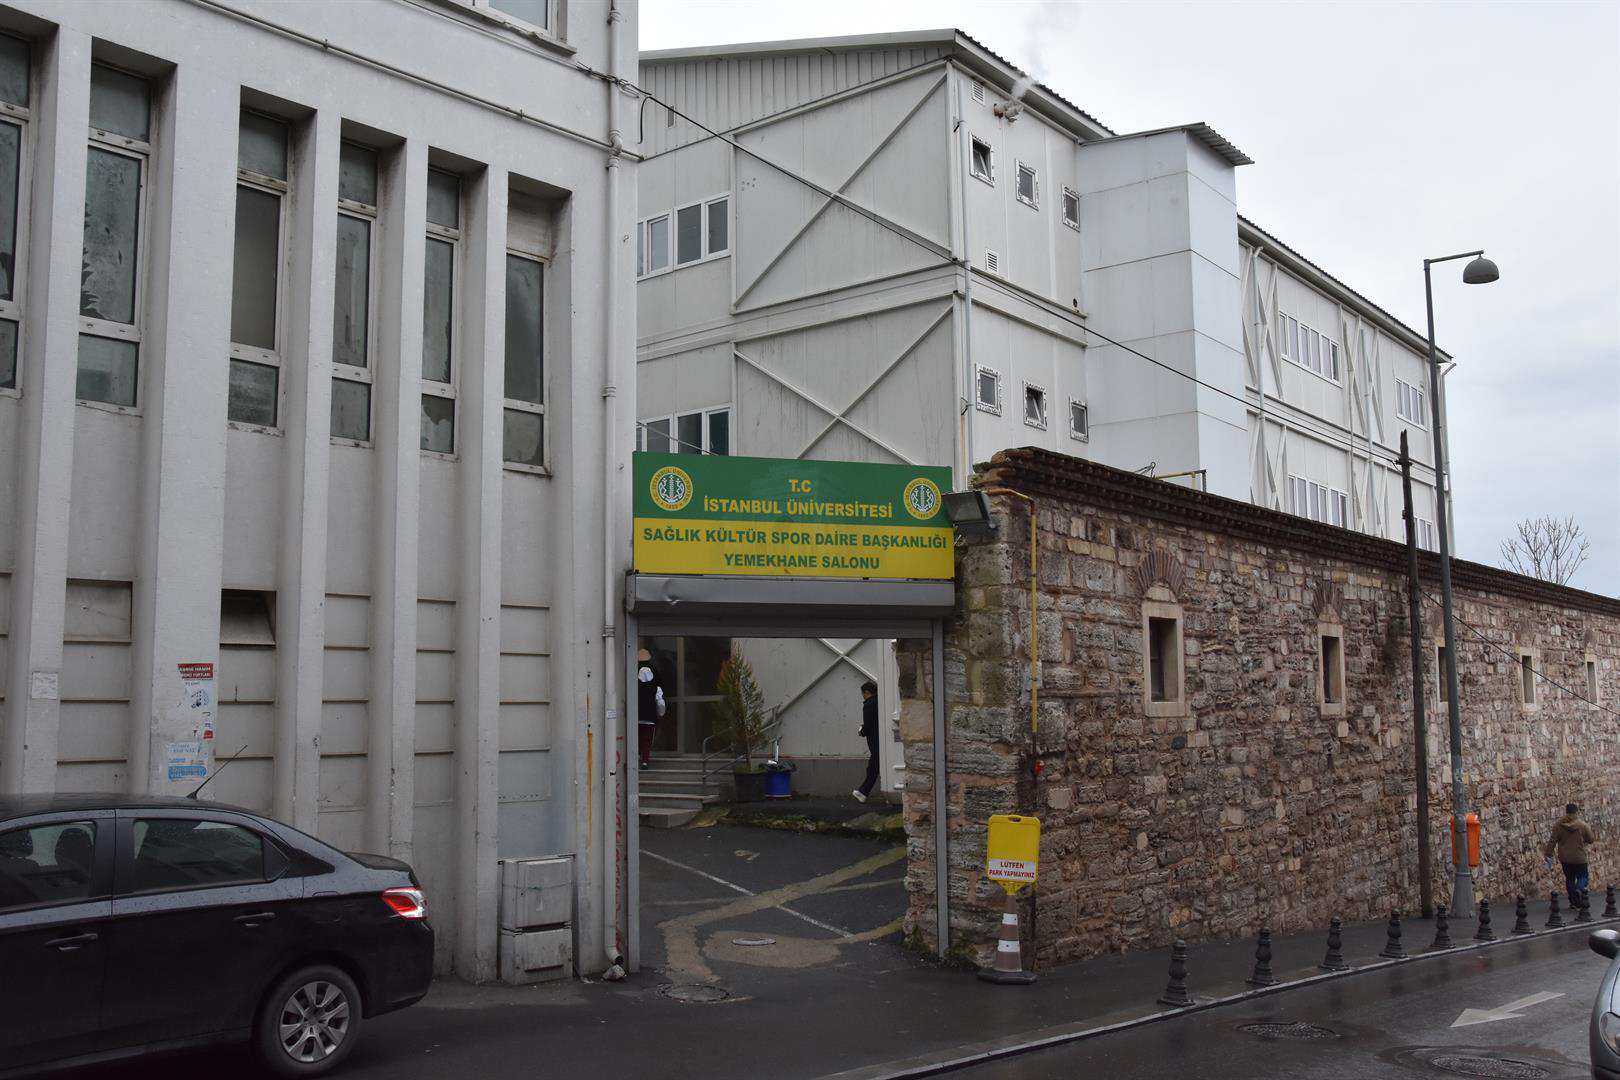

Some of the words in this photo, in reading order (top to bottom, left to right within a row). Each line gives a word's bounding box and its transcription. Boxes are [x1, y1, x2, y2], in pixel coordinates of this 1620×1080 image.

[789, 479, 812, 493] T.C
[703, 495, 782, 514] İSTANBUL
[787, 498, 893, 518] ÜNİVERSİTESİ
[643, 526, 701, 542] SAĞLIK
[705, 527, 767, 544] KÜLTÜR
[771, 531, 810, 545] SPOR
[815, 531, 857, 547] DAİRE
[862, 533, 947, 551] BAŞKANLIĞI
[724, 553, 817, 568] YEMEKHANE
[822, 555, 880, 569] SALONU
